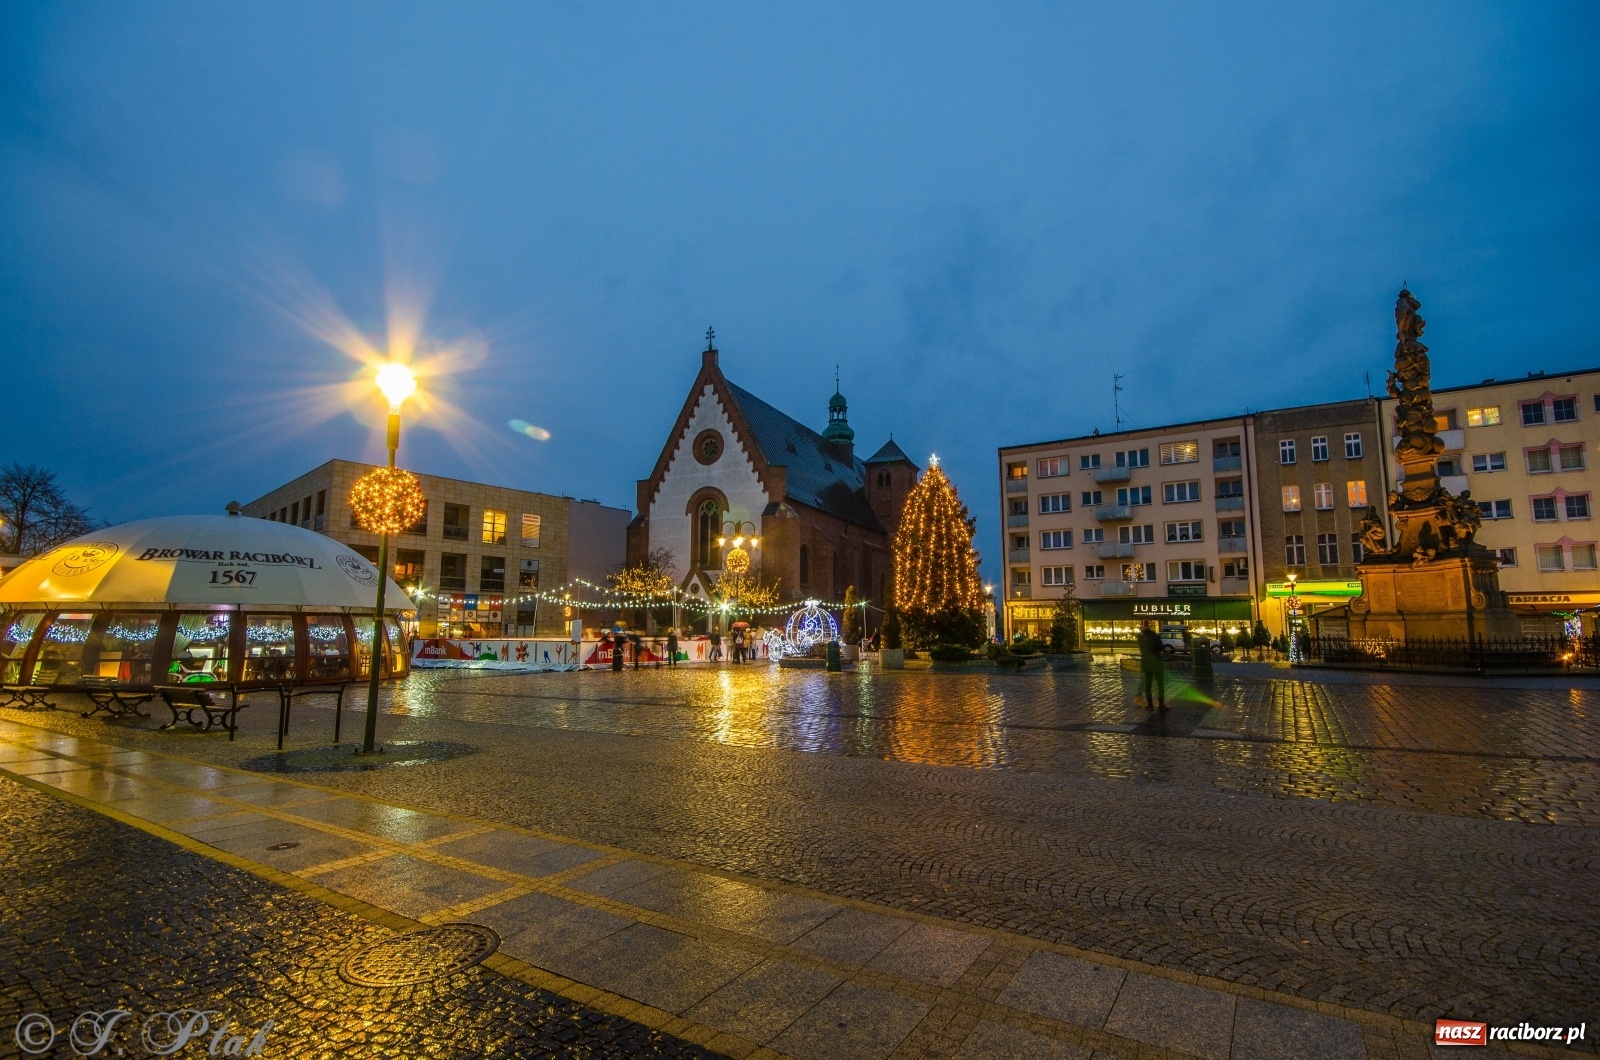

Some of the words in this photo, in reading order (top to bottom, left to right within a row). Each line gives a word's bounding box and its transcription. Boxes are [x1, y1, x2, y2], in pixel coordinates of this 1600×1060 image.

[135, 548, 225, 561] BROWAR
[229, 550, 323, 570] RACIBÓRZ
[208, 569, 258, 586] 1567
[1133, 604, 1191, 612] JUBILER
[424, 645, 447, 655] mBank
[598, 648, 631, 659] mBk
